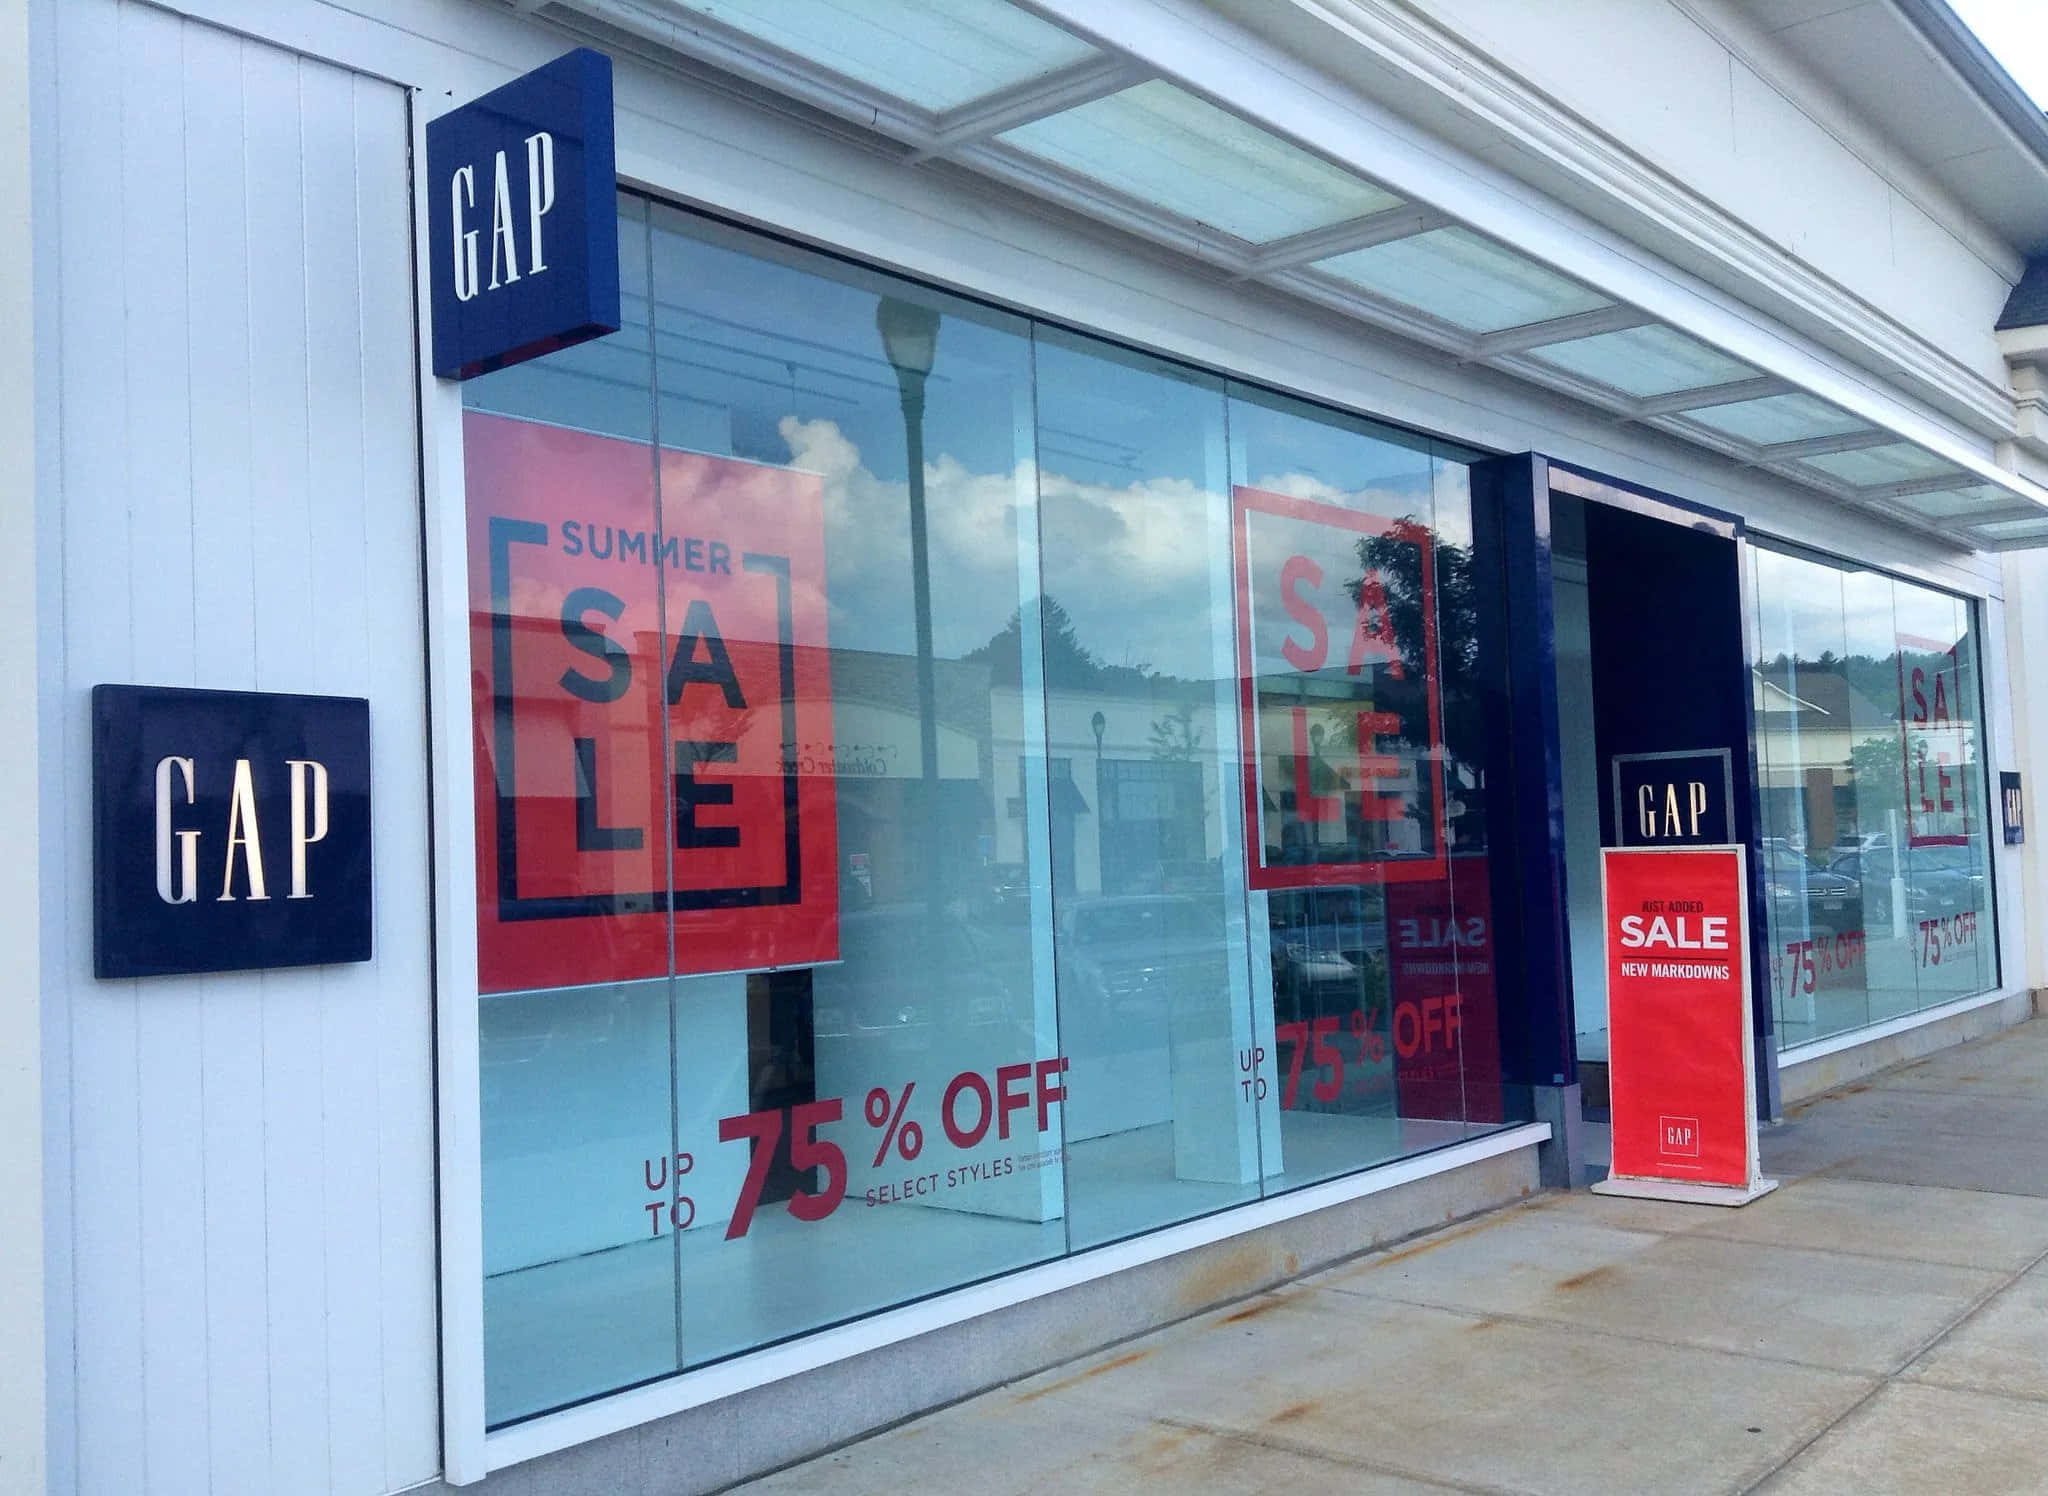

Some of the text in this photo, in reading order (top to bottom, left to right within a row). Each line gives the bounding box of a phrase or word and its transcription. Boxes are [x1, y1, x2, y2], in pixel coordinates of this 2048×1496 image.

[452, 131, 555, 301] GAP
[561, 519, 732, 576] SUMMER
[1638, 781, 1708, 838] GAP
[155, 756, 328, 905] GAP
[1668, 901, 1704, 913] ADDED
[1620, 915, 1729, 950] SALE
[1621, 962, 1730, 981] NEW MARKDOWNS
[1392, 994, 1464, 1058] OFF
[1240, 1047, 1265, 1073] UP
[942, 1057, 1069, 1149] OFF
[1241, 1077, 1267, 1103] TO
[1667, 1126, 1692, 1146] GAP
[645, 1152, 694, 1191] UP
[866, 1174, 938, 1207] SELECT
[947, 1157, 1014, 1187] STYLES
[645, 1196, 696, 1236] TO
